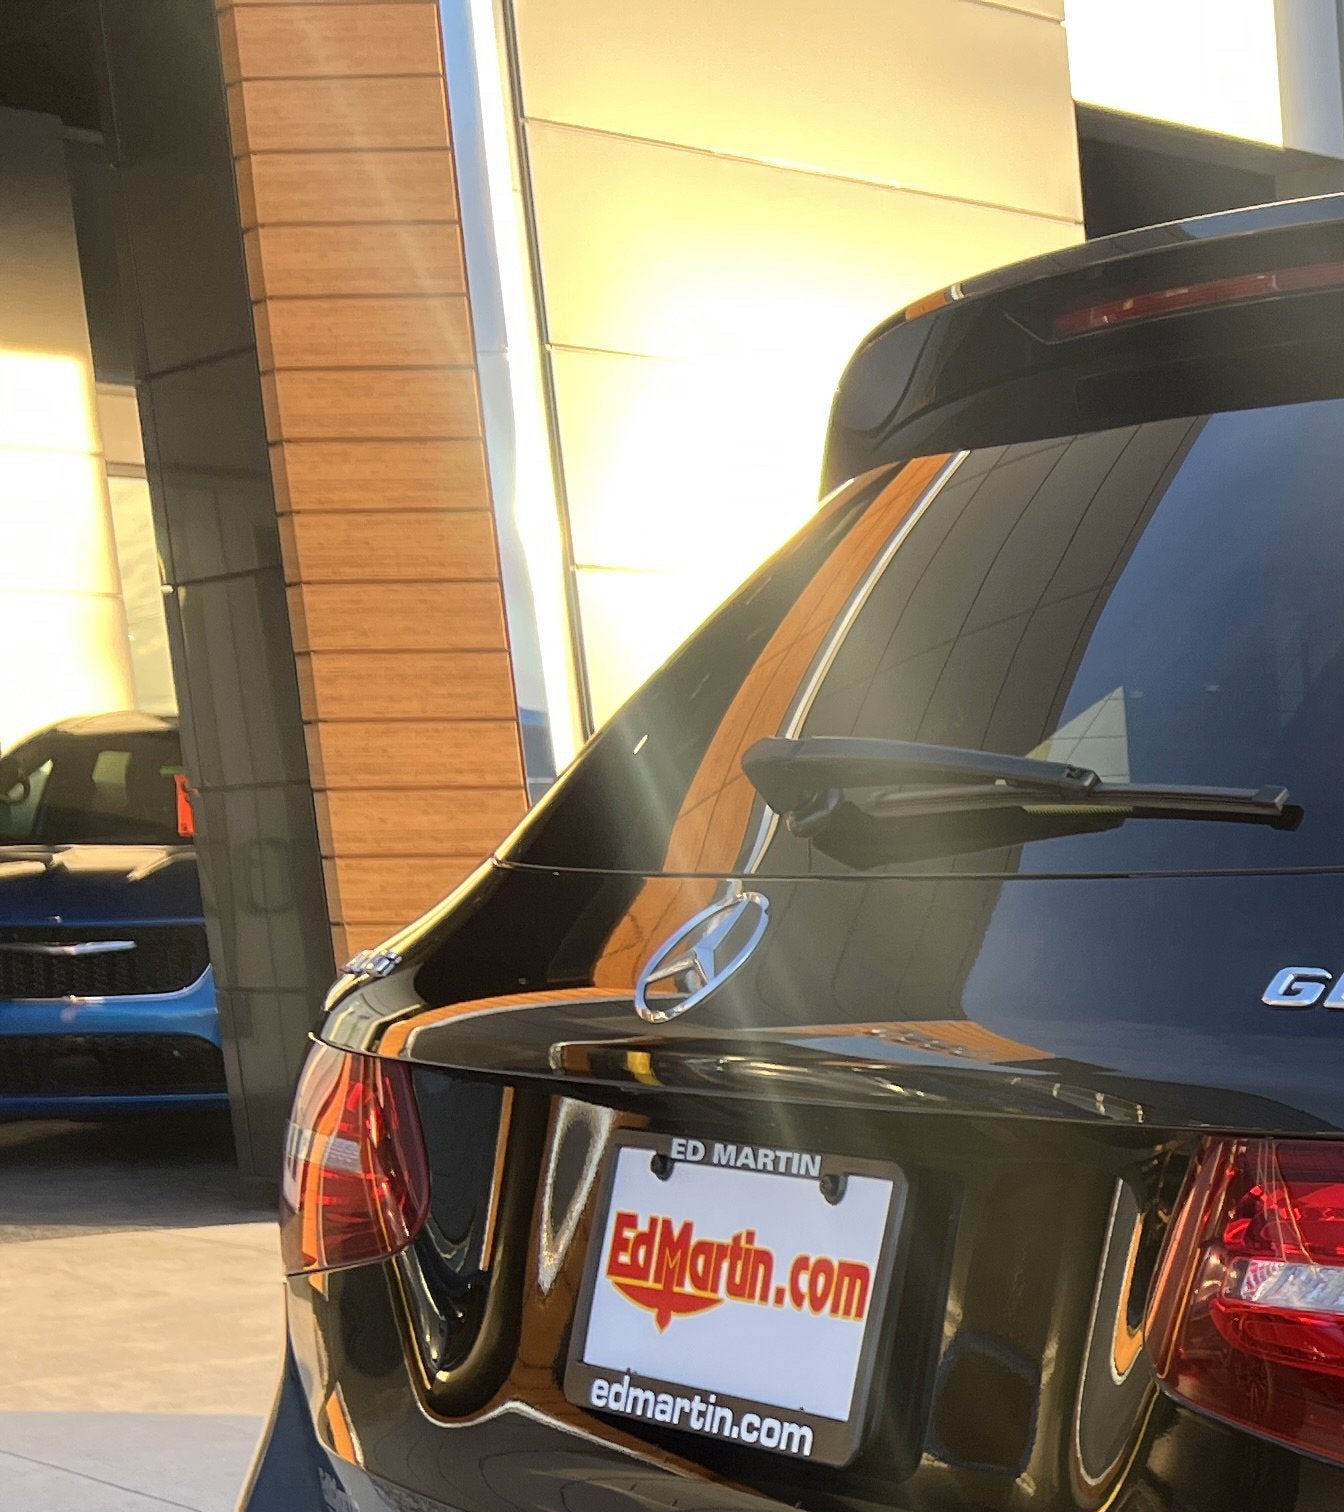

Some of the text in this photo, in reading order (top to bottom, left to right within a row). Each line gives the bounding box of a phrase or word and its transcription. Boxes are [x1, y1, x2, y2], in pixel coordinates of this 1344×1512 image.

[670, 1137, 822, 1177] ED MARTIN
[606, 1210, 871, 1323] EdMartin.com
[590, 1375, 813, 1457] edmartin.com
